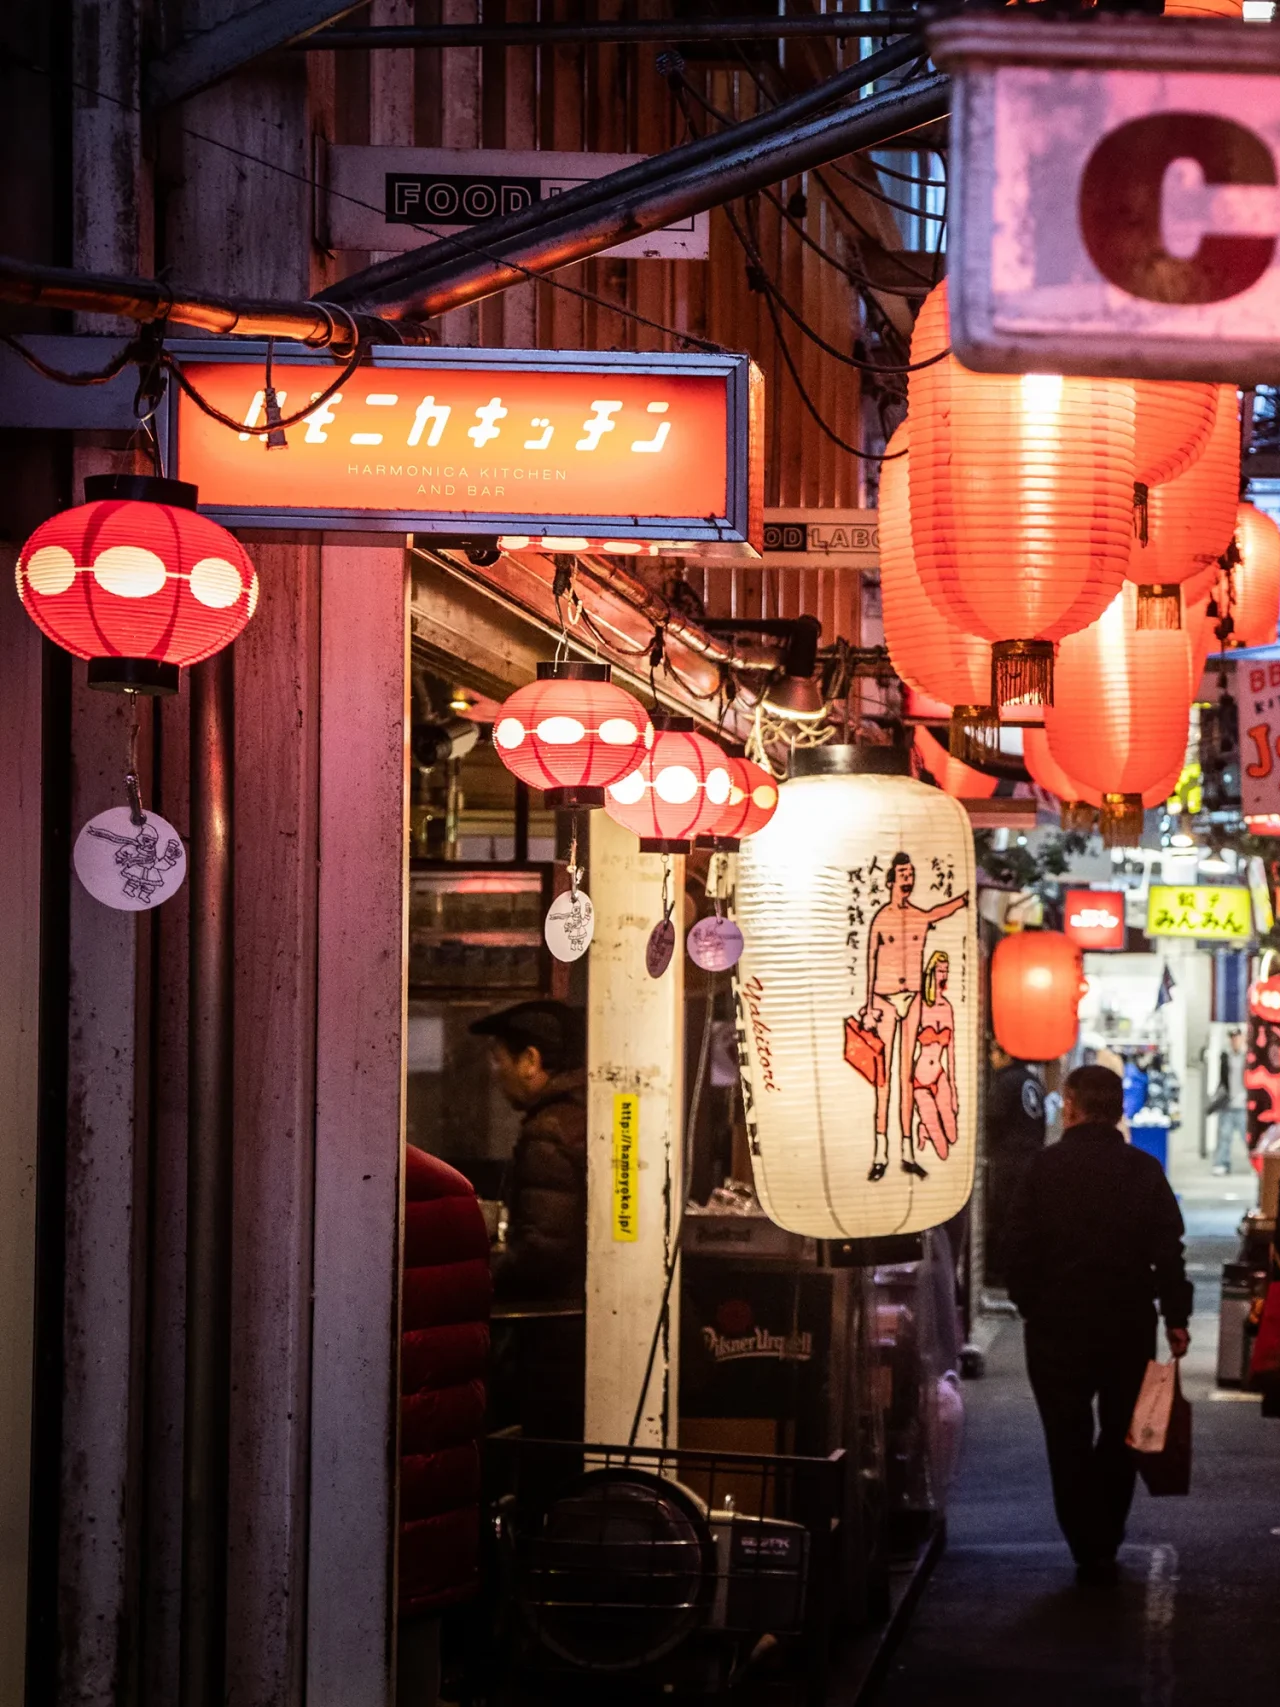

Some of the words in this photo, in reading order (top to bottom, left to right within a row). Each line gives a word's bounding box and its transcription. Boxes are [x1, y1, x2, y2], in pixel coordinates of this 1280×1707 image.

[394, 182, 532, 217] FOOD
[347, 463, 469, 479] HARMONICA
[480, 467, 567, 481] KITCHEN
[416, 484, 456, 496] AND
[468, 485, 507, 497] BAR
[1155, 908, 1244, 934] みんみん
[742, 975, 781, 1094] Yakitori
[617, 1101, 632, 1234] http://hamoyoko.jp/
